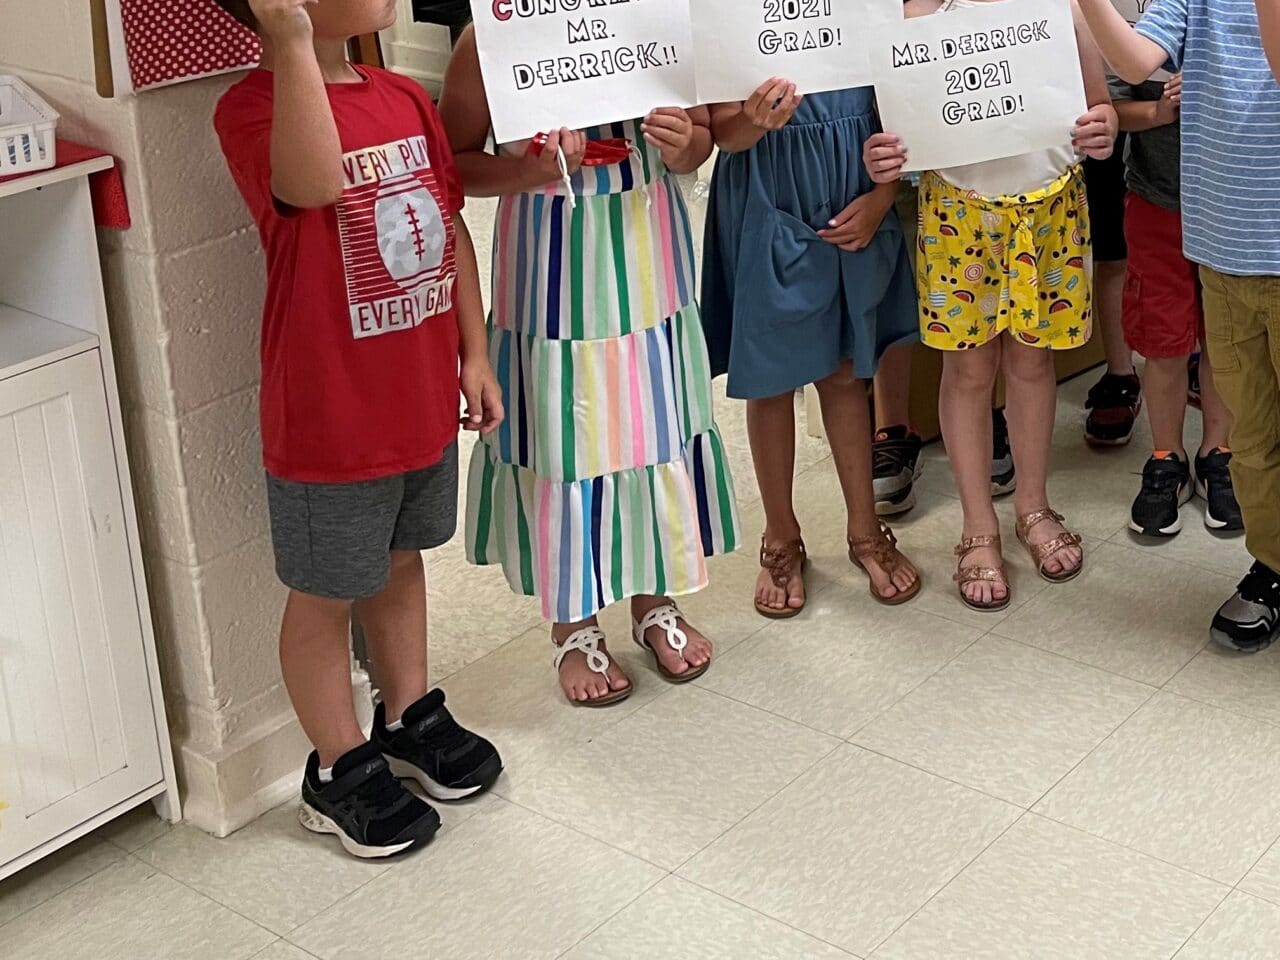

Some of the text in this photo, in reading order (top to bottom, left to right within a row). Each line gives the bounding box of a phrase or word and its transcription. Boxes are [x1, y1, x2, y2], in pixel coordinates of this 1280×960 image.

[567, 17, 616, 44] MR.
[758, 28, 842, 55] GRAD!
[892, 20, 1051, 68] MR. DERRICK
[513, 41, 679, 90] DERRICK!!
[945, 60, 1012, 95] 2021
[943, 94, 1024, 125] GRAD!
[342, 149, 393, 185] VERY
[358, 295, 420, 331] EVERY
